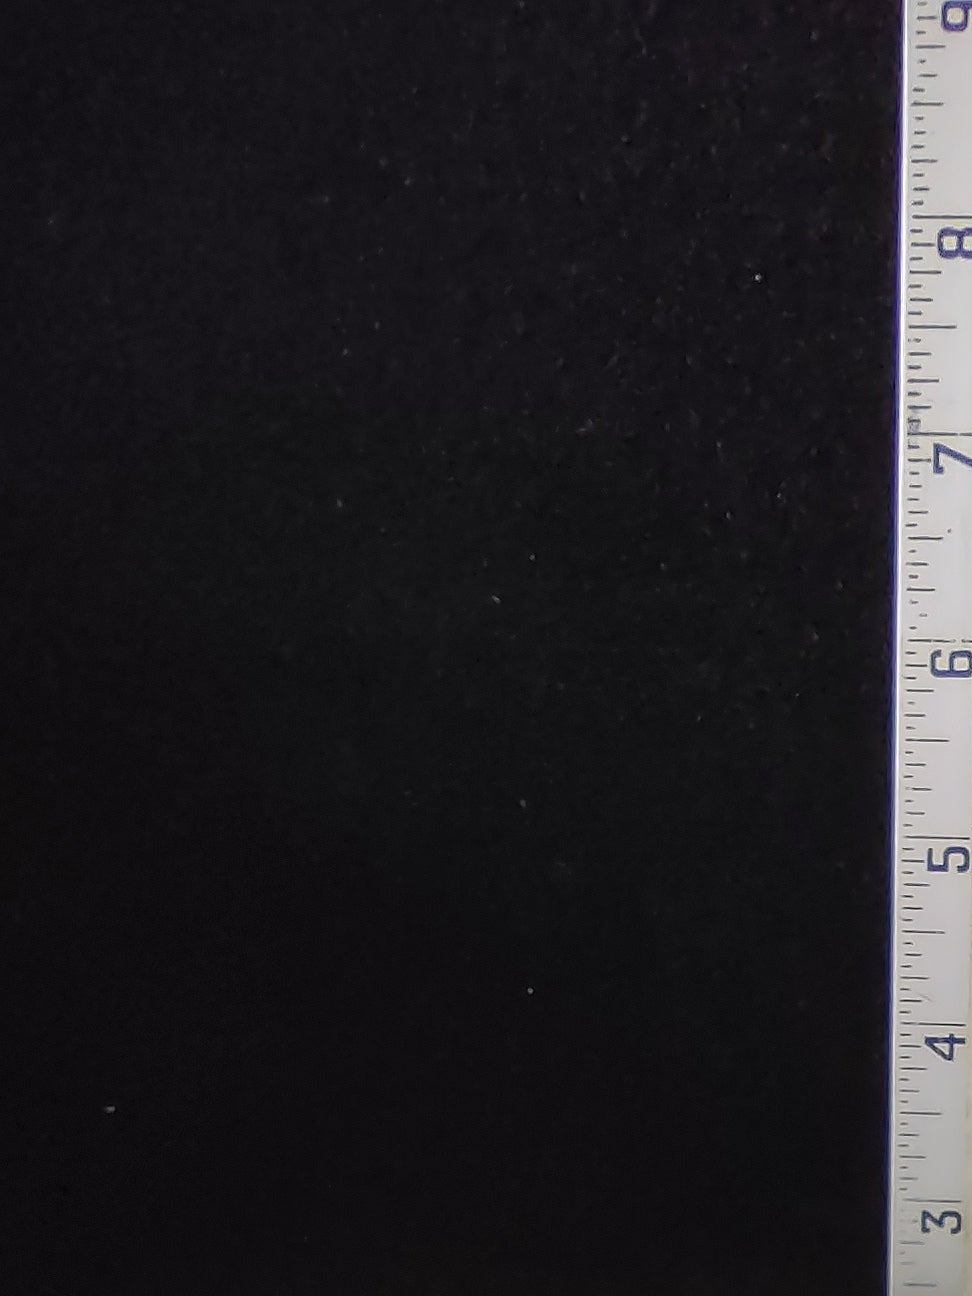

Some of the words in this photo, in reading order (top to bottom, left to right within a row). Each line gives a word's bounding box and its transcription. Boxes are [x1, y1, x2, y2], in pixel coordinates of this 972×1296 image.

[927, 846, 970, 873] 5
[924, 1033, 966, 1061] 4
[921, 1210, 962, 1235] 3
